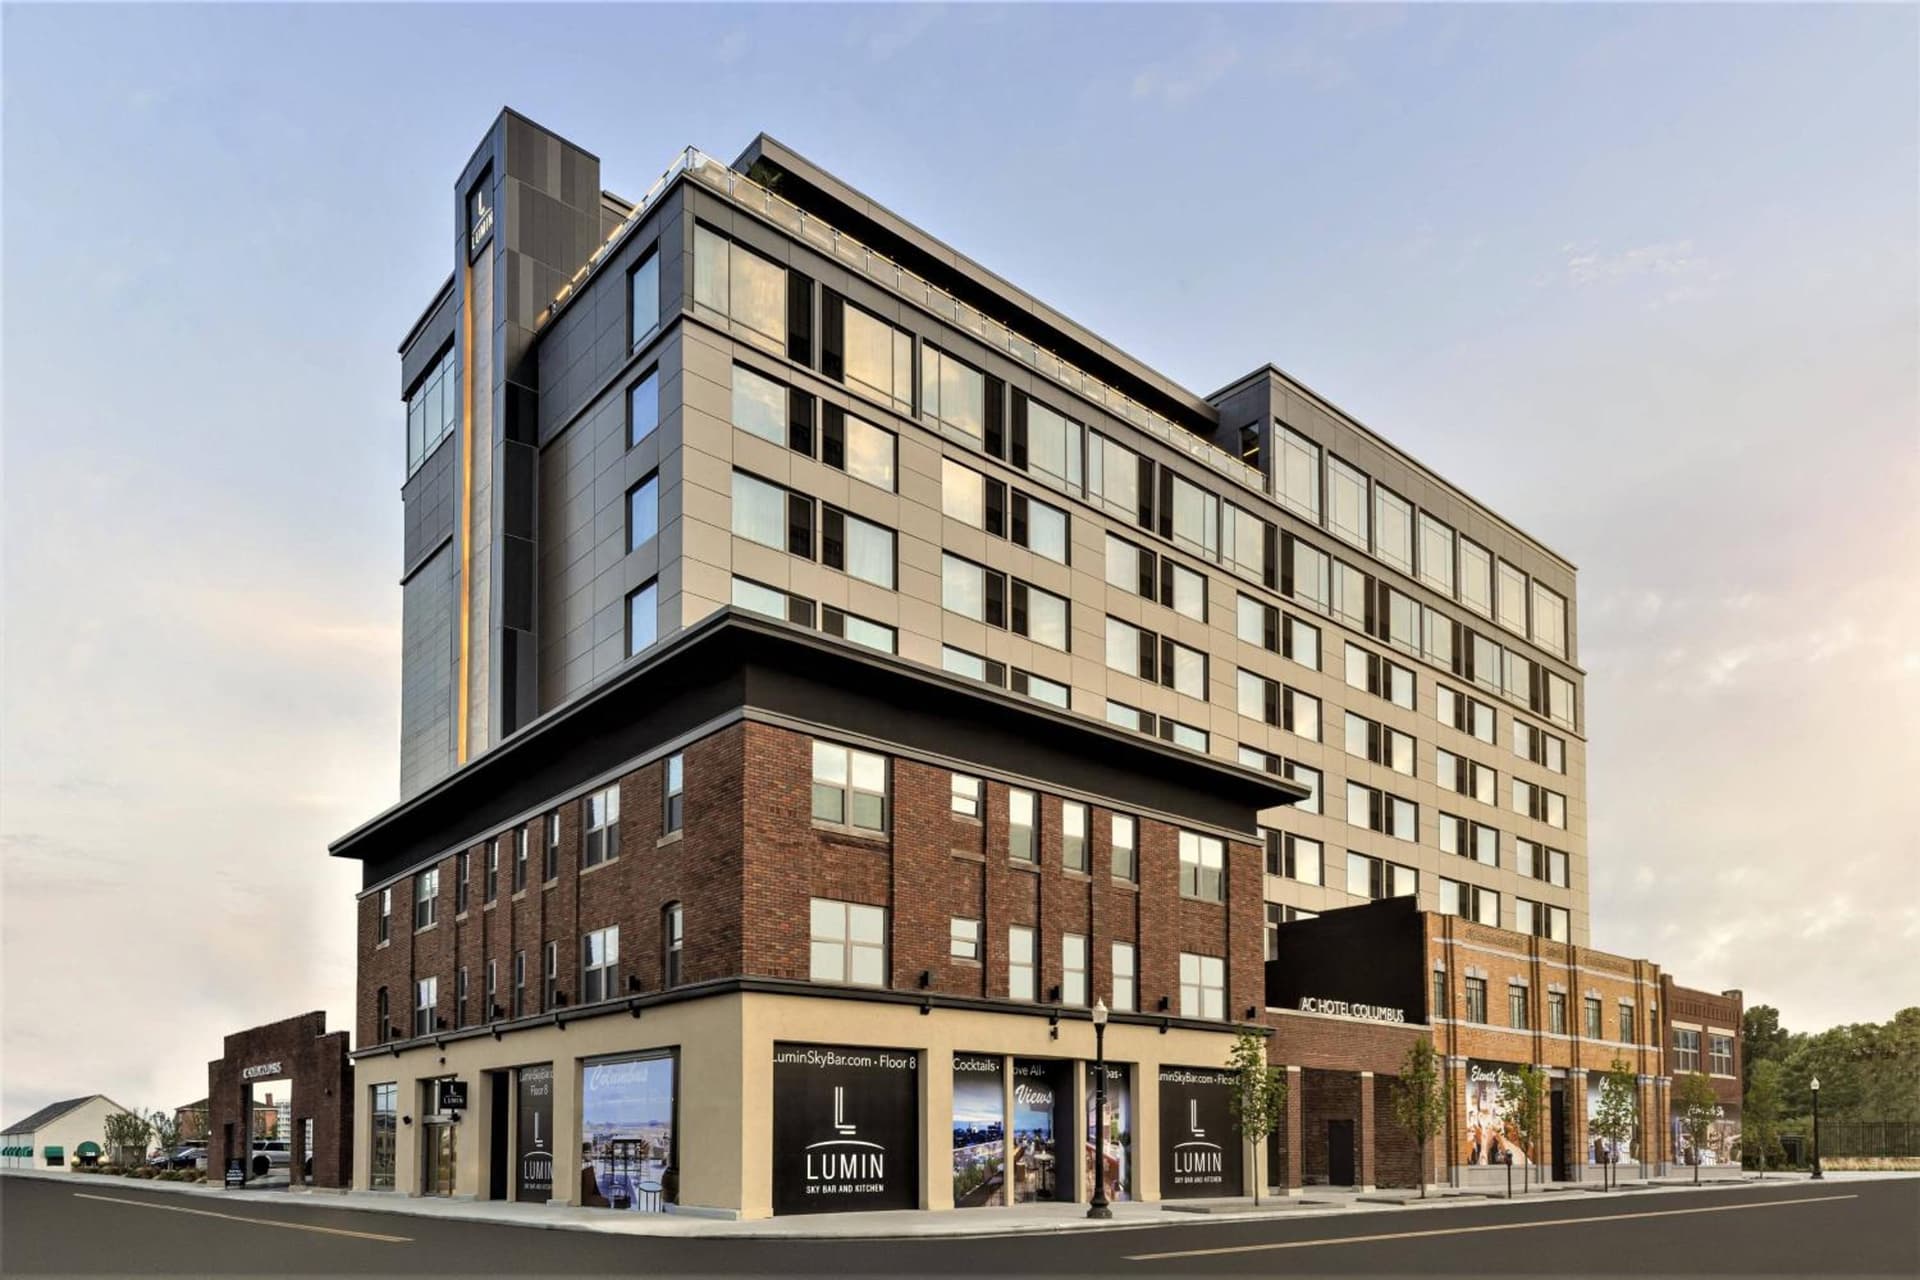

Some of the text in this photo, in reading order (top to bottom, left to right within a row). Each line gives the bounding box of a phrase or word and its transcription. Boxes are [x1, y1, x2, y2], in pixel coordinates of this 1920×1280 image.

[471, 210, 493, 250] LUMIN
[1301, 996, 1405, 1023] AC HOTEL COLUMBUS
[772, 1050, 917, 1070] uminSkyBar.com Floor 8
[952, 1057, 996, 1072] Cocktails
[1015, 1084, 1053, 1105] Views
[806, 1153, 884, 1180] LUMIN
[1174, 1151, 1222, 1173] LUMIN
[806, 1183, 884, 1194] SKY BAR AND KITCHEN
